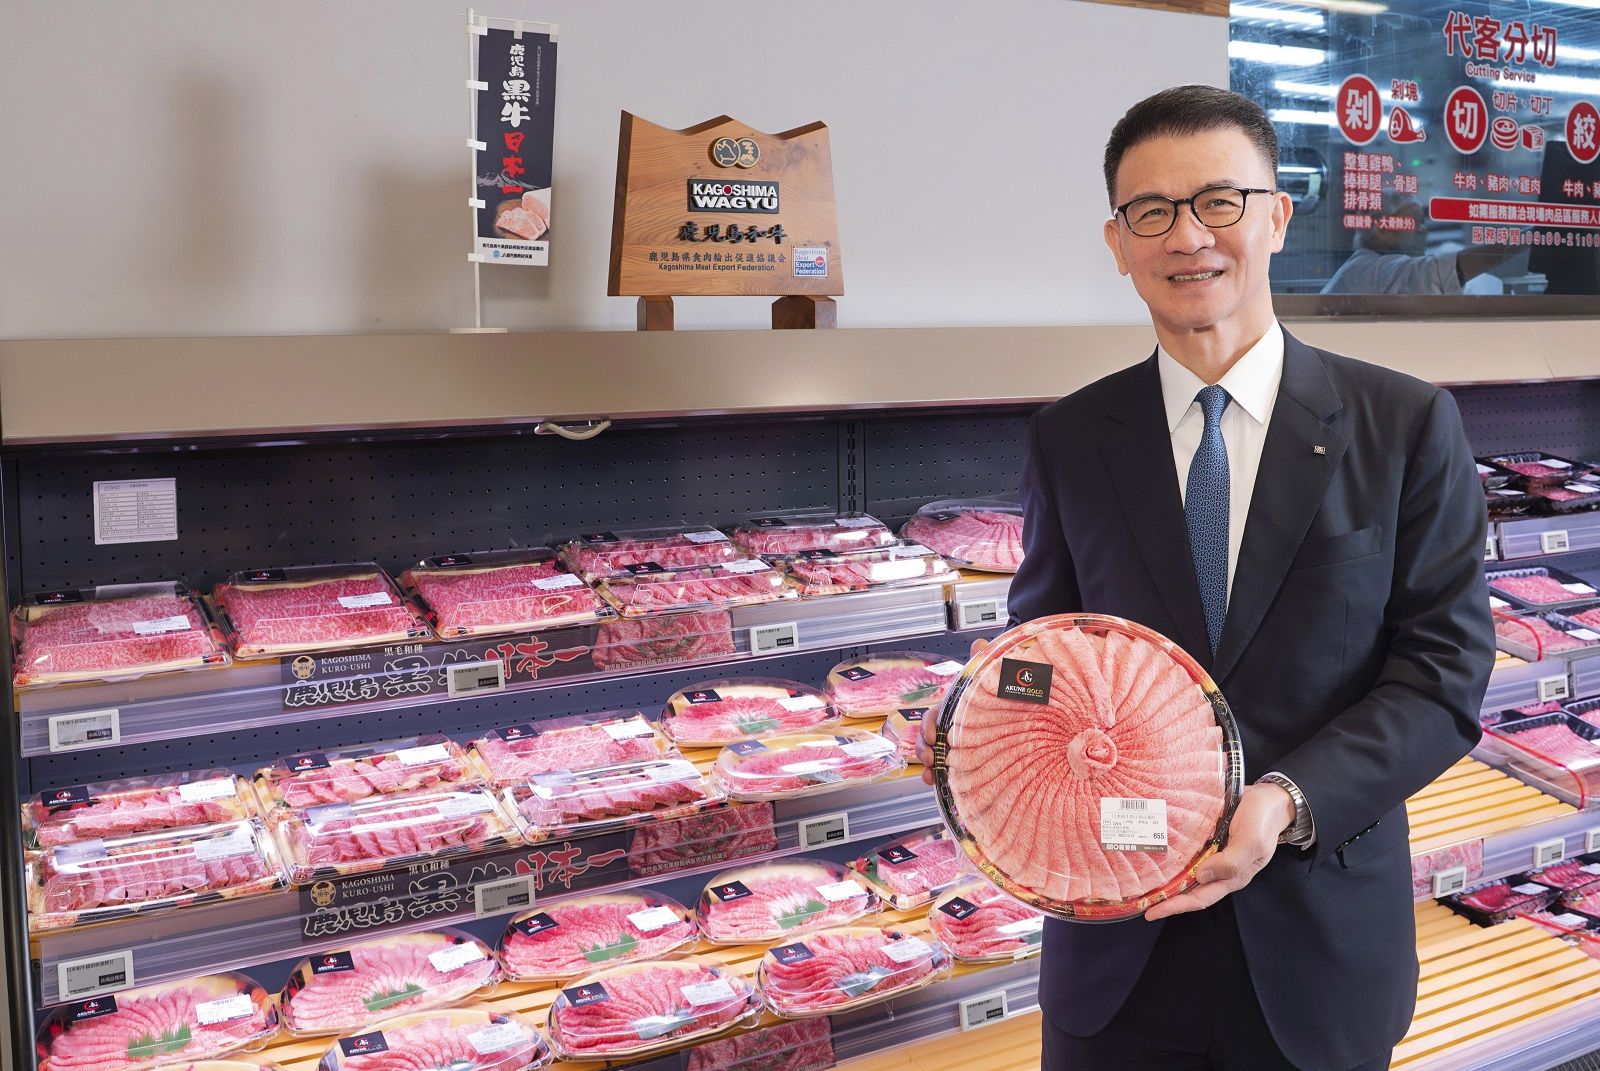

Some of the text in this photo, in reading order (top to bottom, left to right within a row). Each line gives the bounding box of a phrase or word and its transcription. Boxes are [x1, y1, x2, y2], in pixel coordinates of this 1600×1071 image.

[1443, 11, 1557, 68] 代客分切
[1466, 63, 1536, 84] Cutting Service
[1391, 79, 1419, 102] 剁塊
[1345, 89, 1373, 131] 剁
[1494, 91, 1554, 115] 切片、切丁
[1453, 99, 1479, 140] 切
[1573, 113, 1597, 150] 絞
[692, 182, 777, 197] KAGOSHIMA
[1454, 172, 1541, 194] 牛肉、豬肉、雞肉
[694, 195, 778, 210] WAGYU
[1344, 191, 1382, 211] 排骨類
[1469, 203, 1600, 225] 如需服務請洽現場肉品區服務人
[794, 248, 826, 257] Kagoshima
[658, 263, 694, 271] Kagoshima
[712, 264, 735, 272] Export
[795, 262, 815, 270] Export
[795, 268, 826, 276] Federation
[320, 654, 372, 665] KAGOSHIMA
[321, 662, 371, 674] KURO-USHI
[1005, 685, 1026, 693] AKUNE
[341, 874, 396, 889] KAGOSHIMA
[342, 883, 395, 899] KURO-USHI
